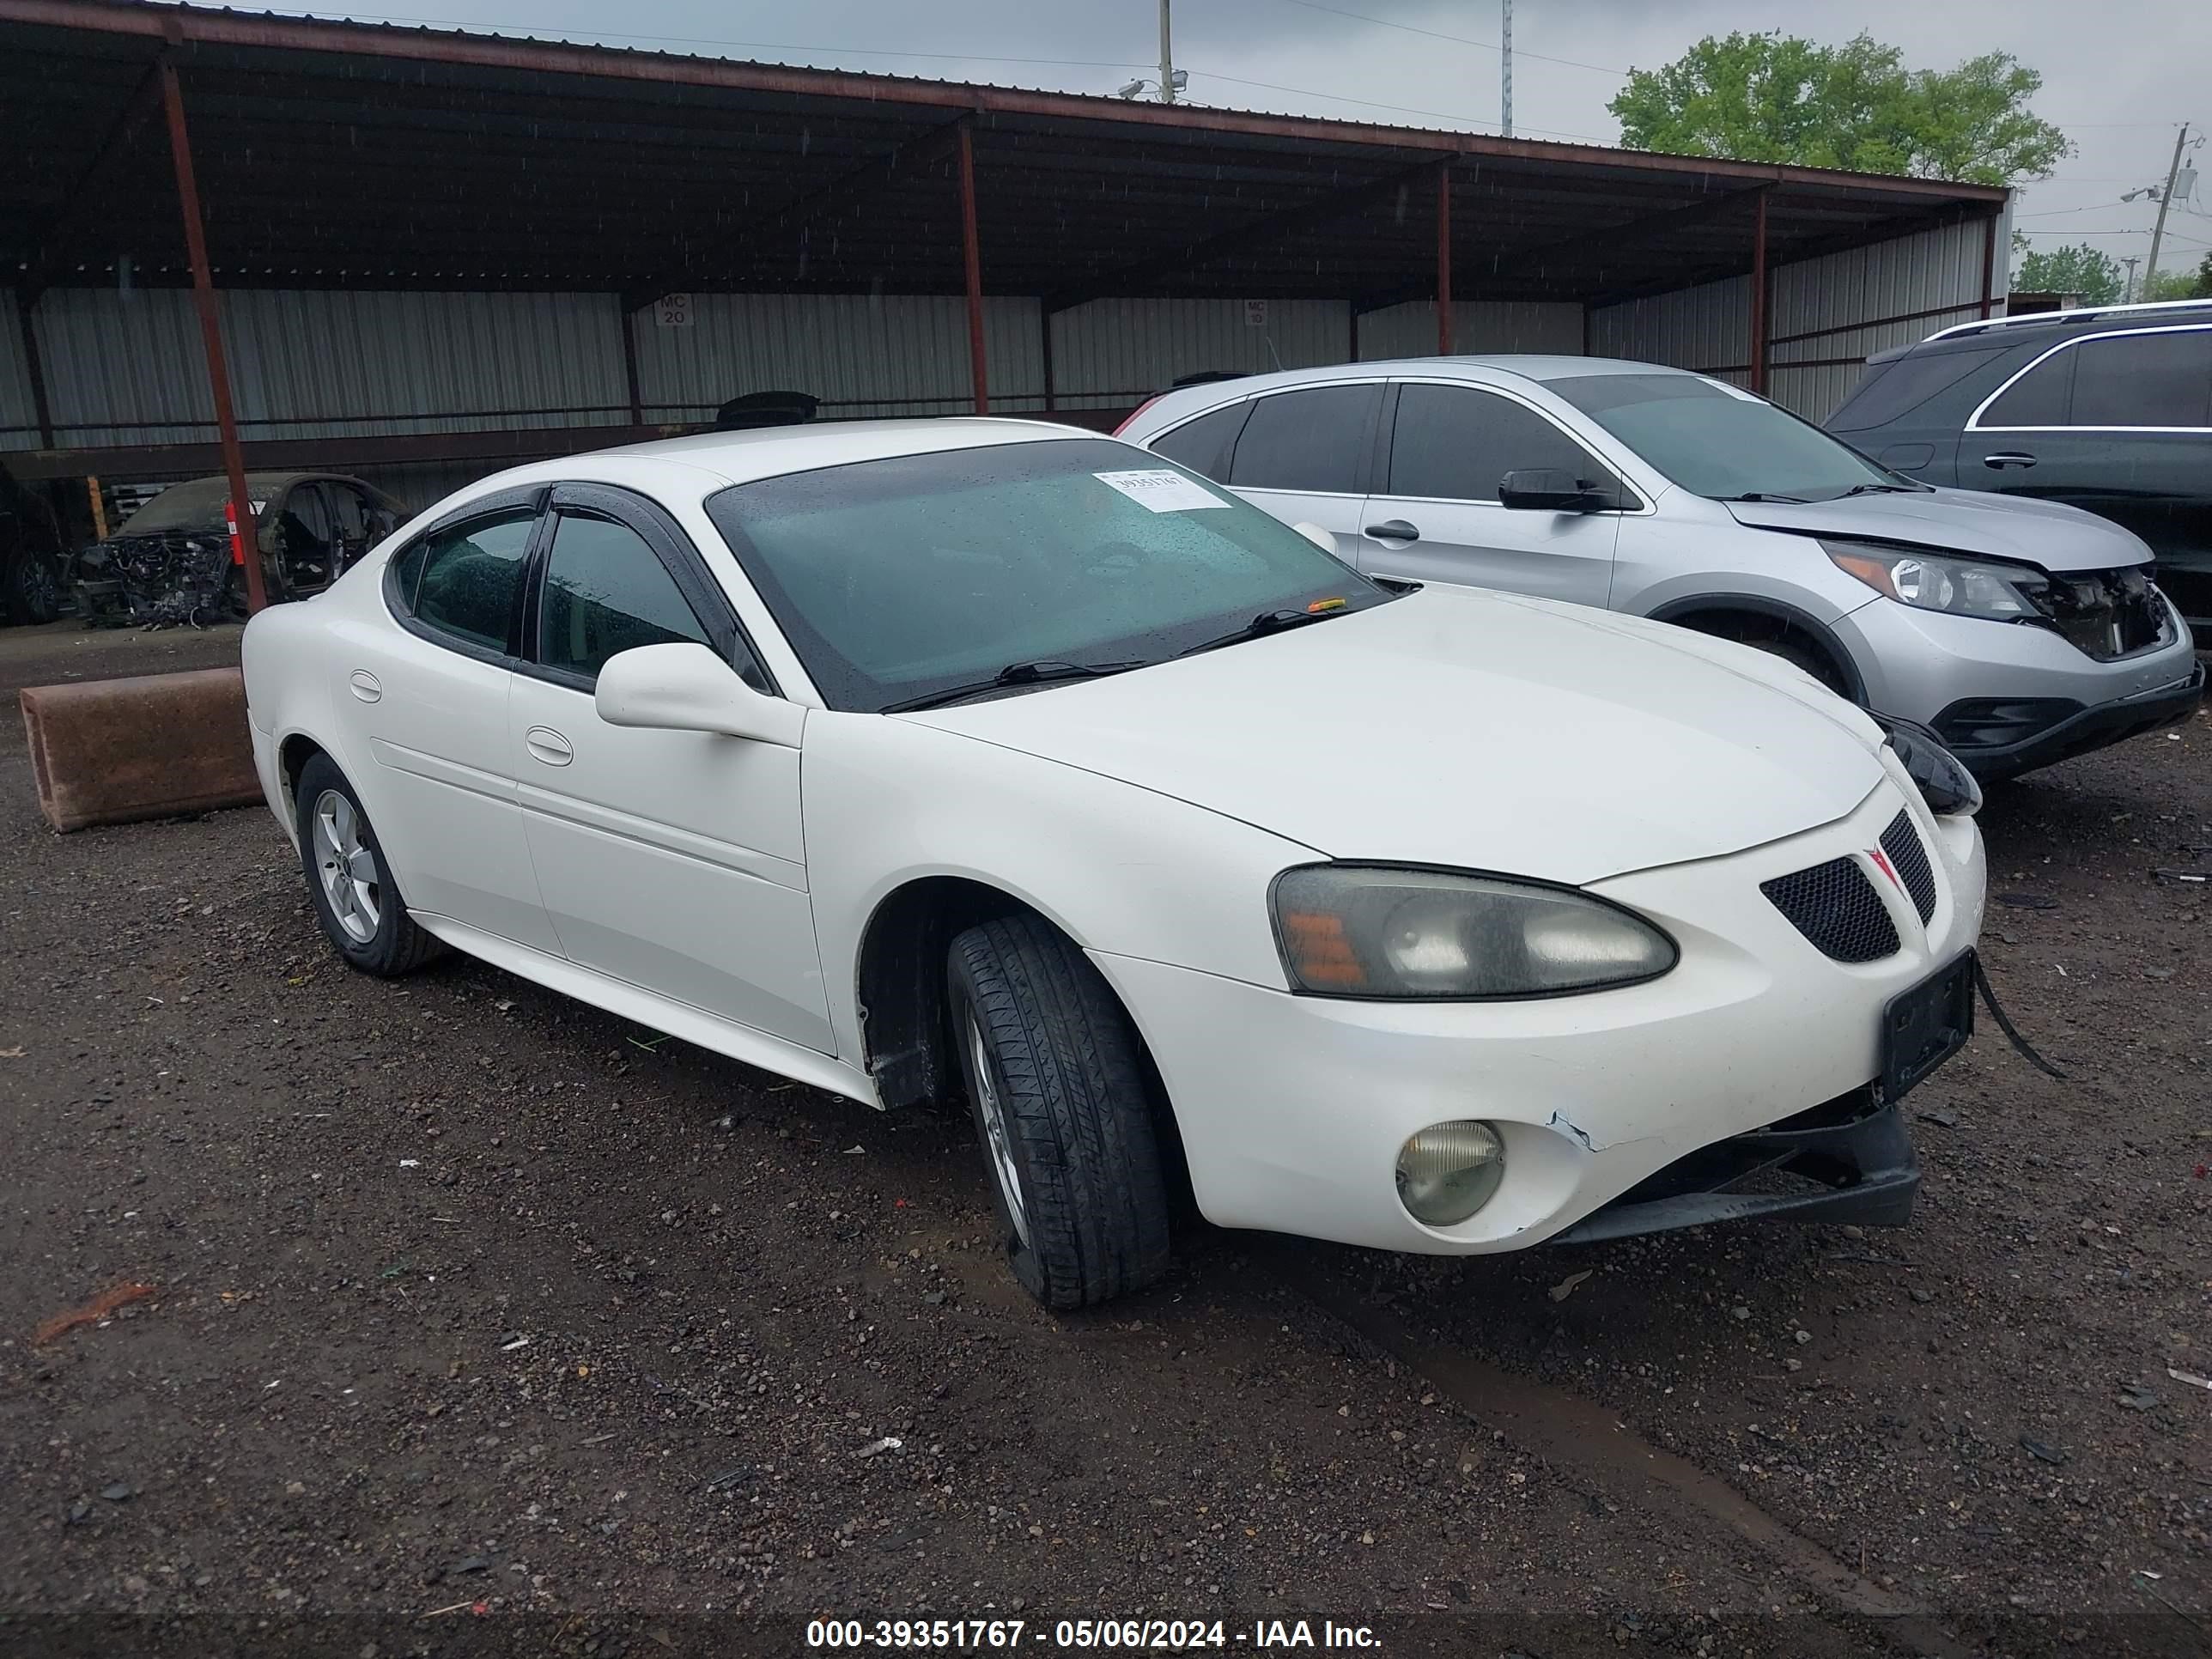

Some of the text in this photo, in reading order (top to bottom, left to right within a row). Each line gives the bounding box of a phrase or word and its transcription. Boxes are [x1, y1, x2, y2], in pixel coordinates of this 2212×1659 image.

[659, 295, 686, 308] MC
[665, 311, 684, 324] 20
[1115, 477, 1182, 489] 39351767
